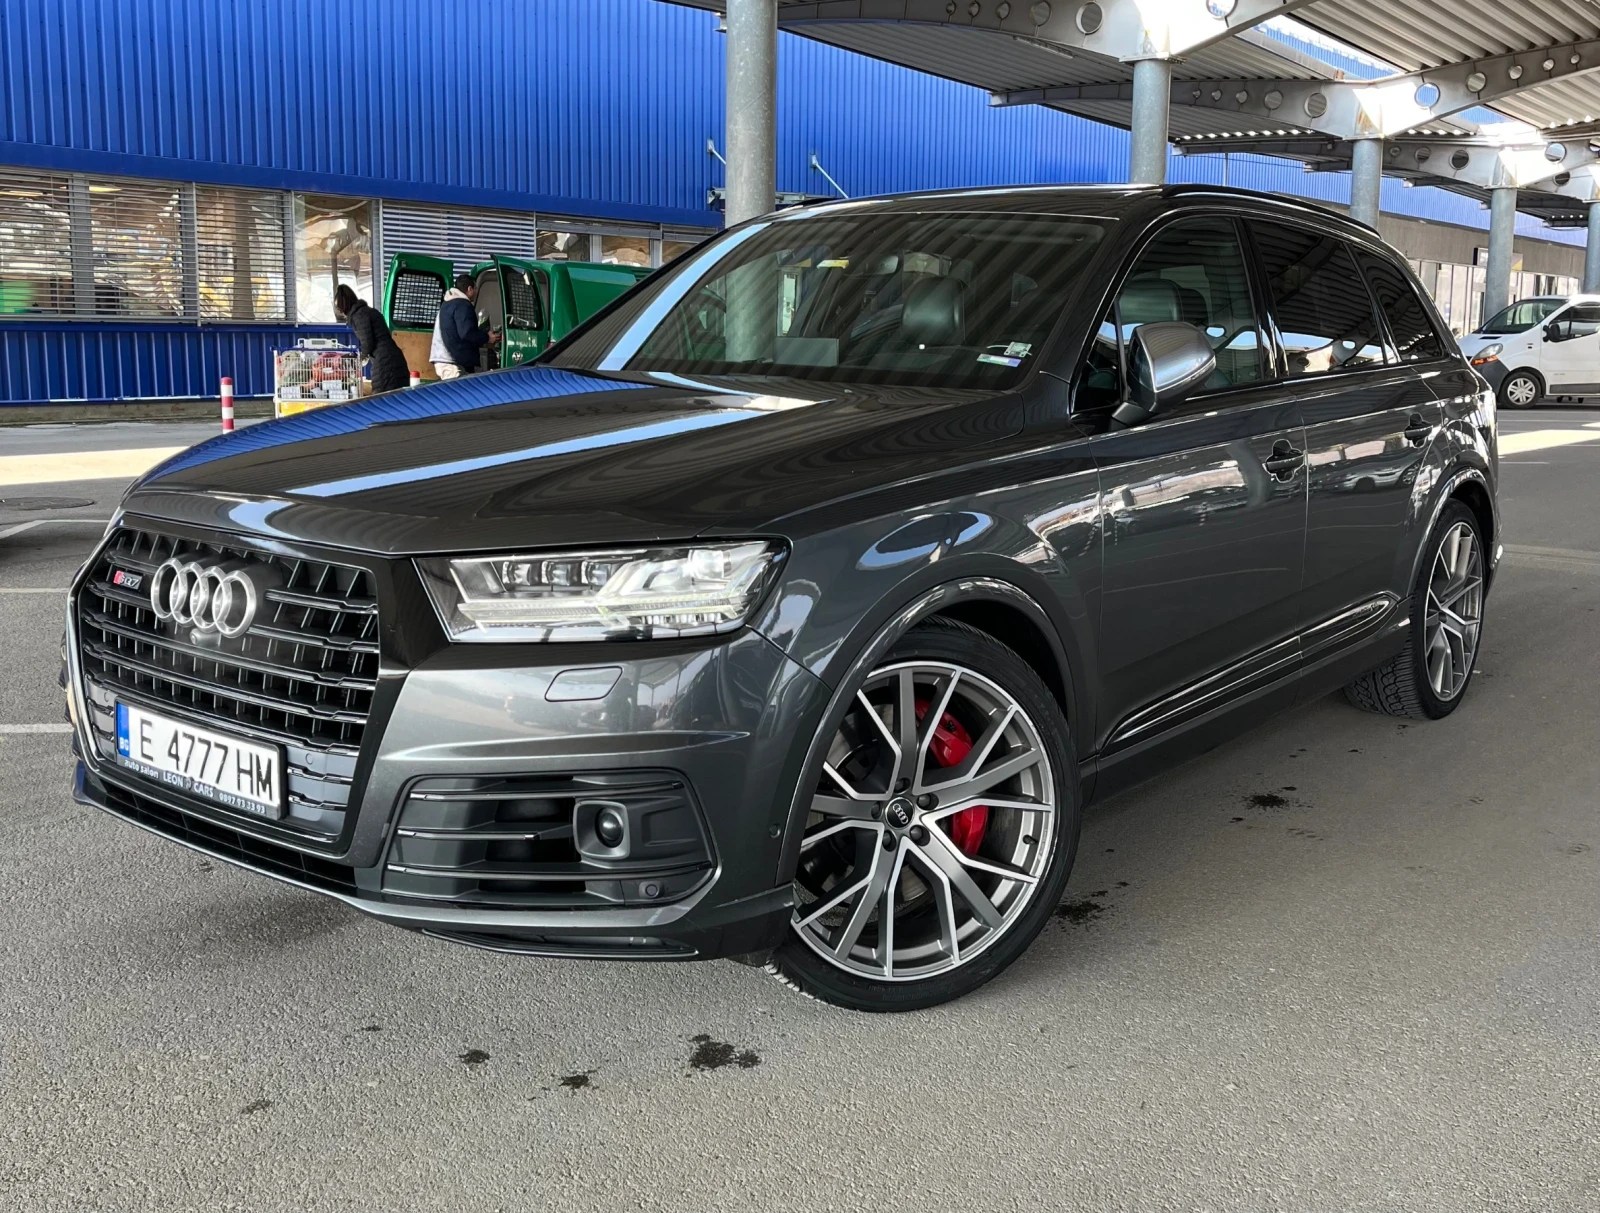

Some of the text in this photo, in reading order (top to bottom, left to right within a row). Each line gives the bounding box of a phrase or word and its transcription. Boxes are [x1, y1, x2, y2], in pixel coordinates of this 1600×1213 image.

[115, 571, 140, 588] SQ7
[119, 737, 130, 751] BG
[140, 718, 273, 802] E 4777 HM
[124, 759, 139, 771] auto
[140, 765, 159, 779] salon
[163, 771, 184, 788] LEON
[193, 782, 214, 798] CARS
